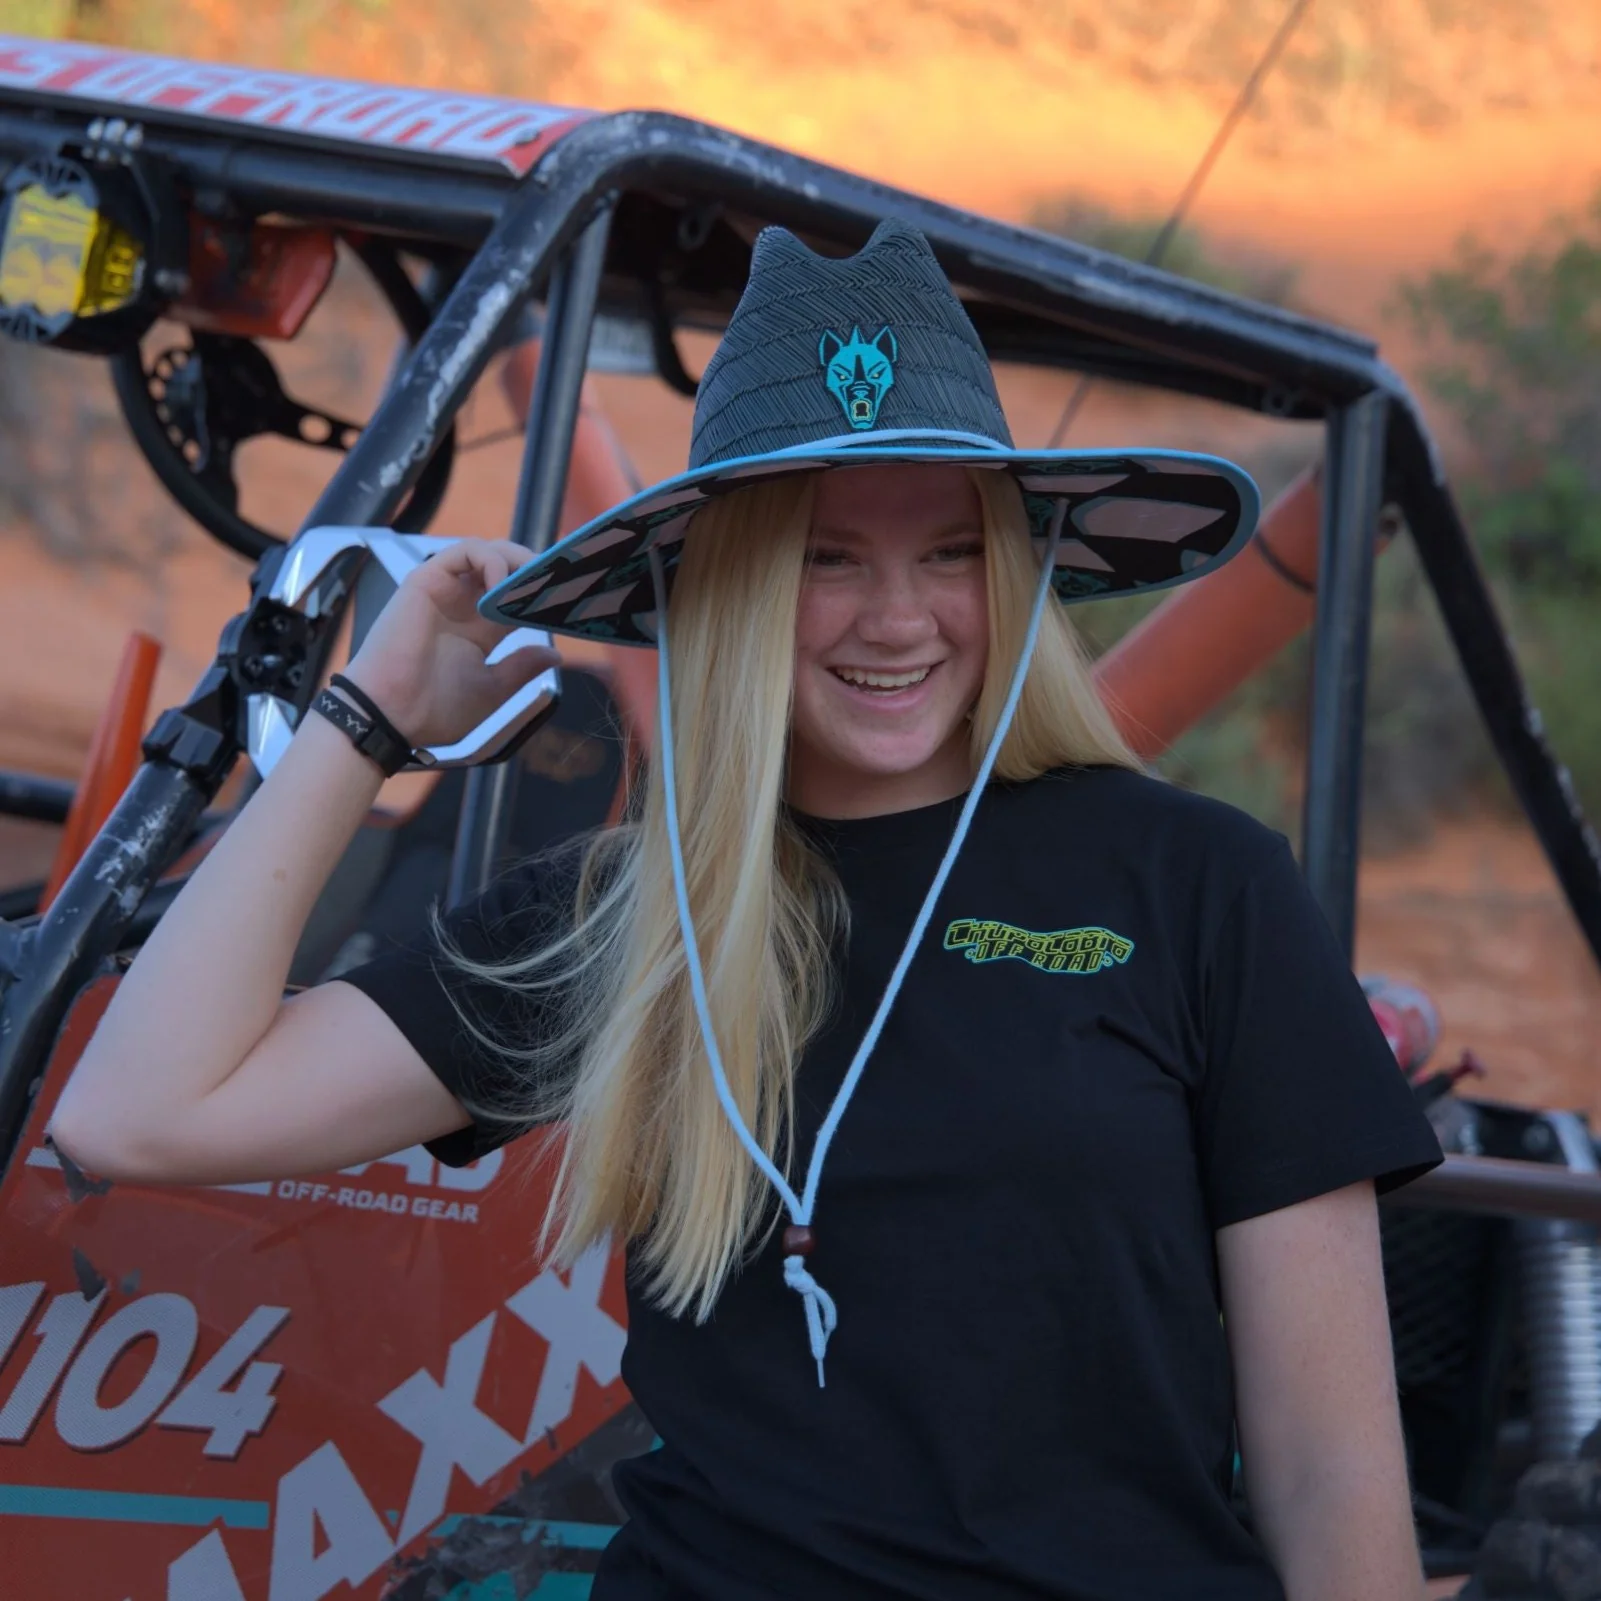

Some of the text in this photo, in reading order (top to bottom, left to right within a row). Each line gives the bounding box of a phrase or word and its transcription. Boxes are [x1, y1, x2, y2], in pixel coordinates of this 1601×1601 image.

[973, 940, 1103, 973] OFF ROAD
[277, 1179, 480, 1224] OFF-ROAD GEAR
